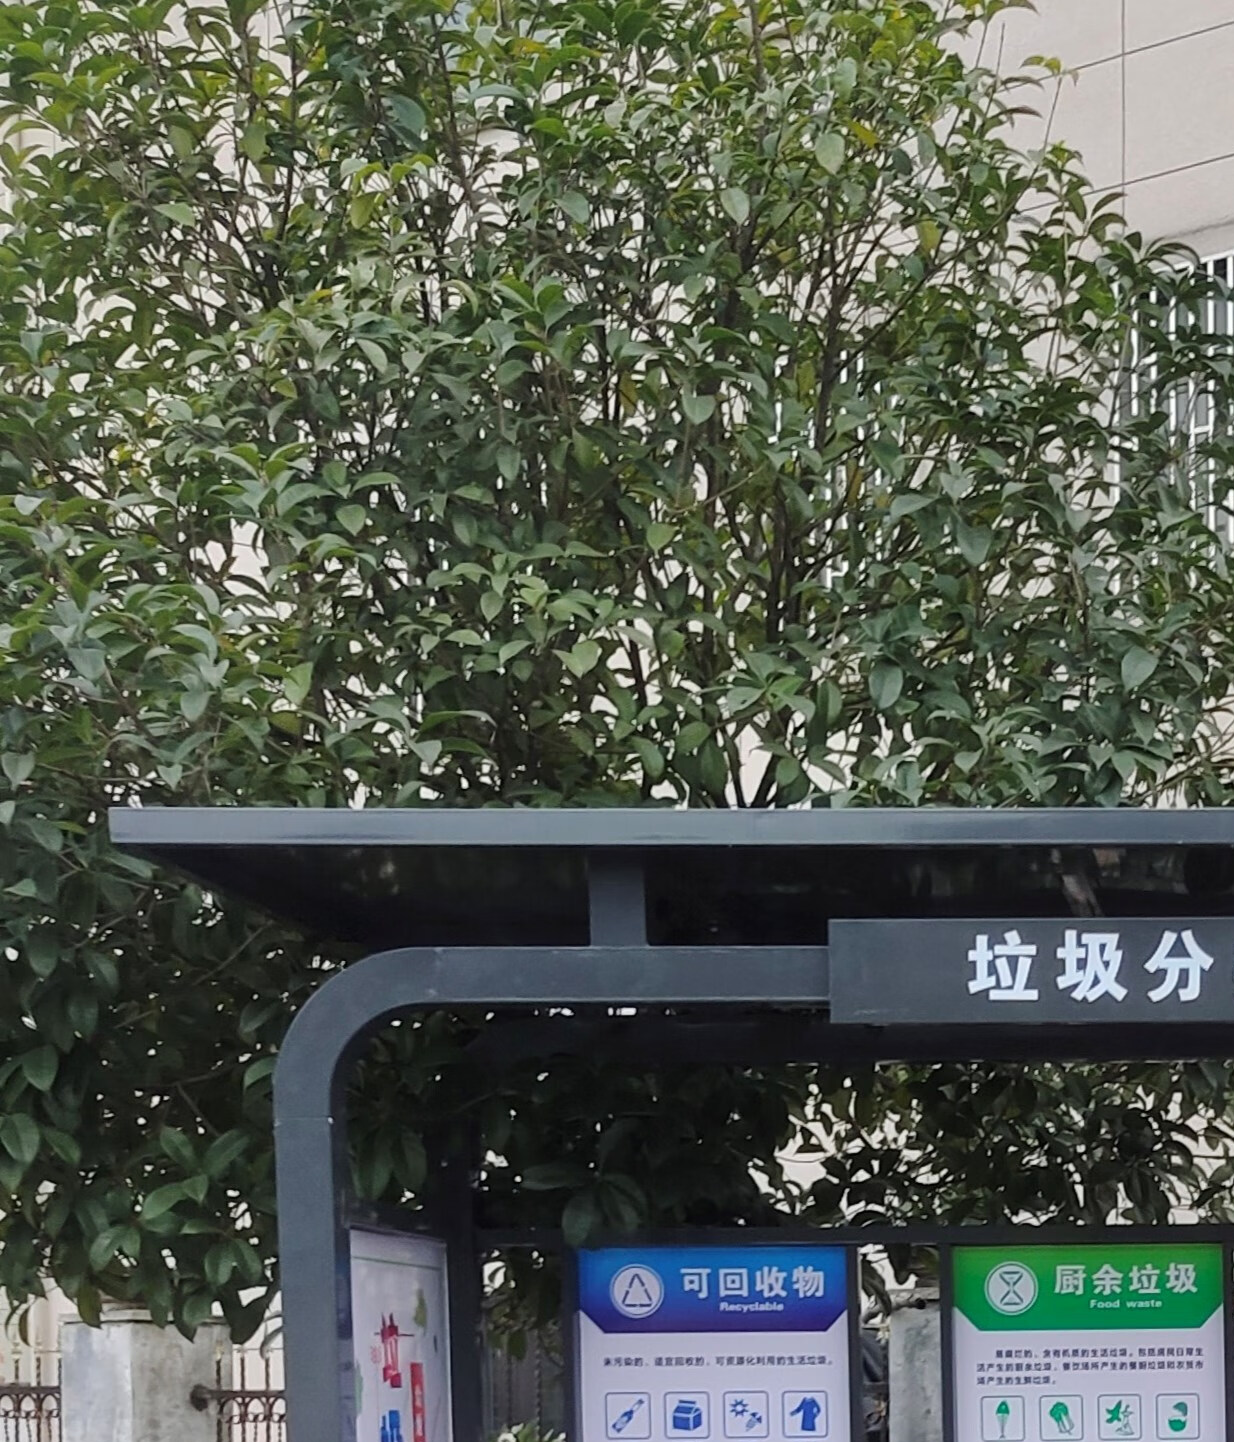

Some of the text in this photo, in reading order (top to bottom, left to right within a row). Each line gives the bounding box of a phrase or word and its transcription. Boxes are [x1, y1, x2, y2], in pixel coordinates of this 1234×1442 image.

[680, 1265, 825, 1299] 可回收物
[1053, 1262, 1198, 1296] 厨余垃圾
[719, 1301, 785, 1313] Recyclable
[1089, 1299, 1163, 1309] Food waste
